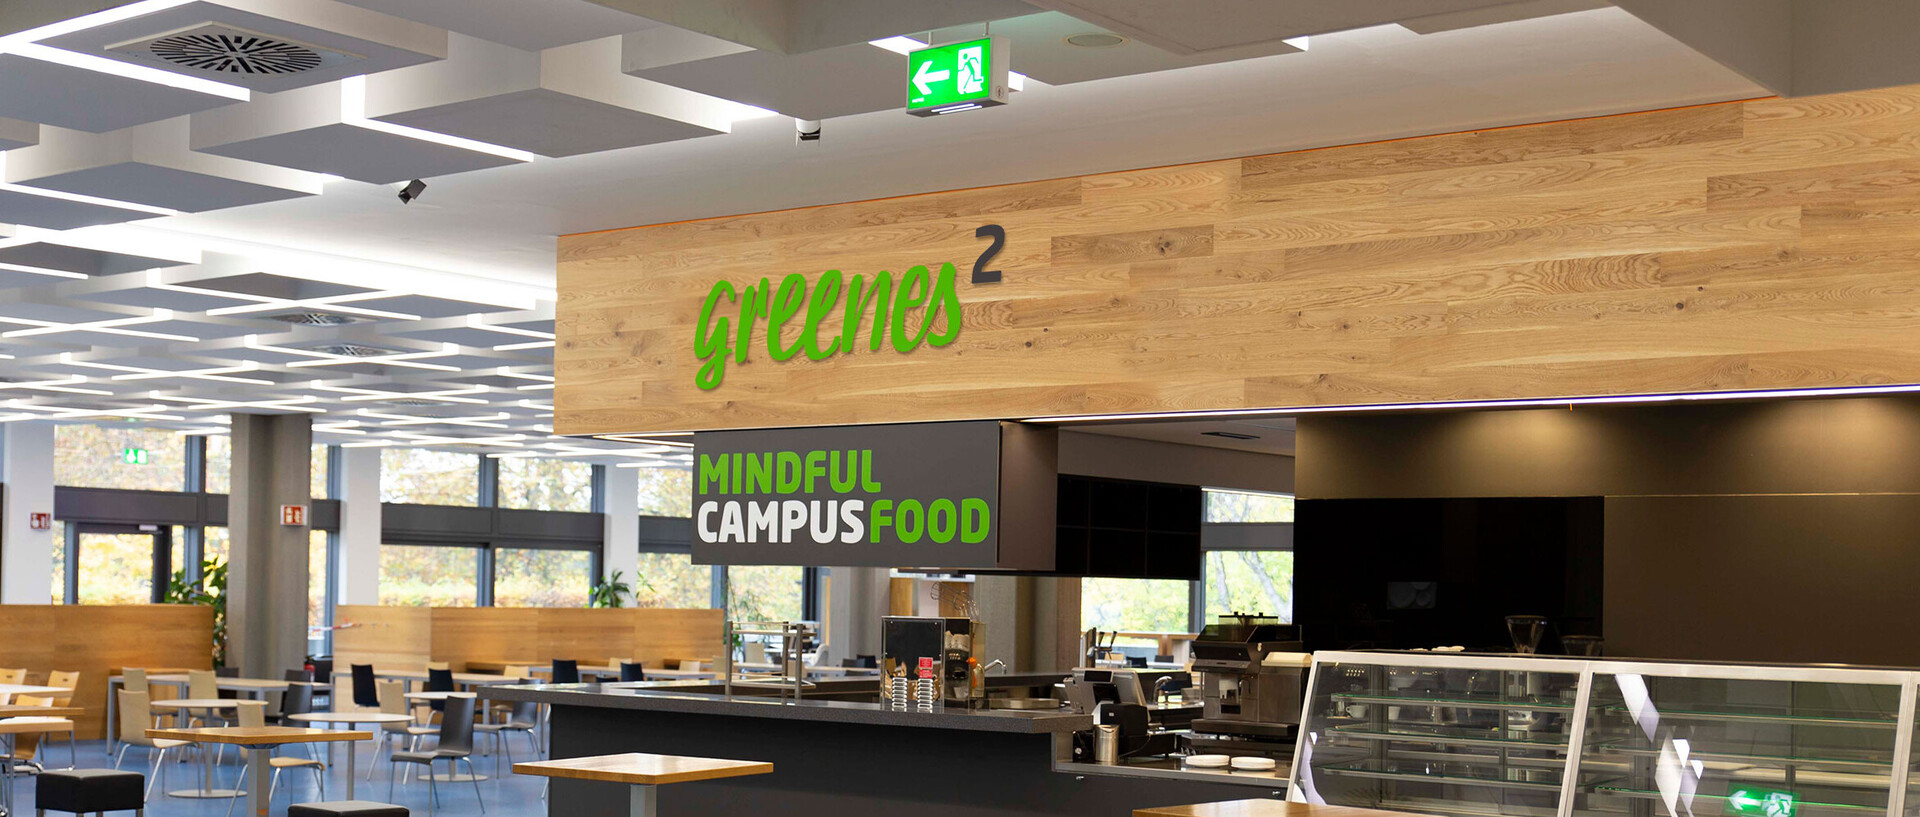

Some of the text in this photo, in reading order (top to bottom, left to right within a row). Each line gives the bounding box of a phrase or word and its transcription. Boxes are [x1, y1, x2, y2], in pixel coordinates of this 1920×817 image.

[694, 224, 1006, 390] greenes 2
[698, 449, 881, 495] MINDFUL
[697, 498, 990, 544] CAMPUS FOOD
